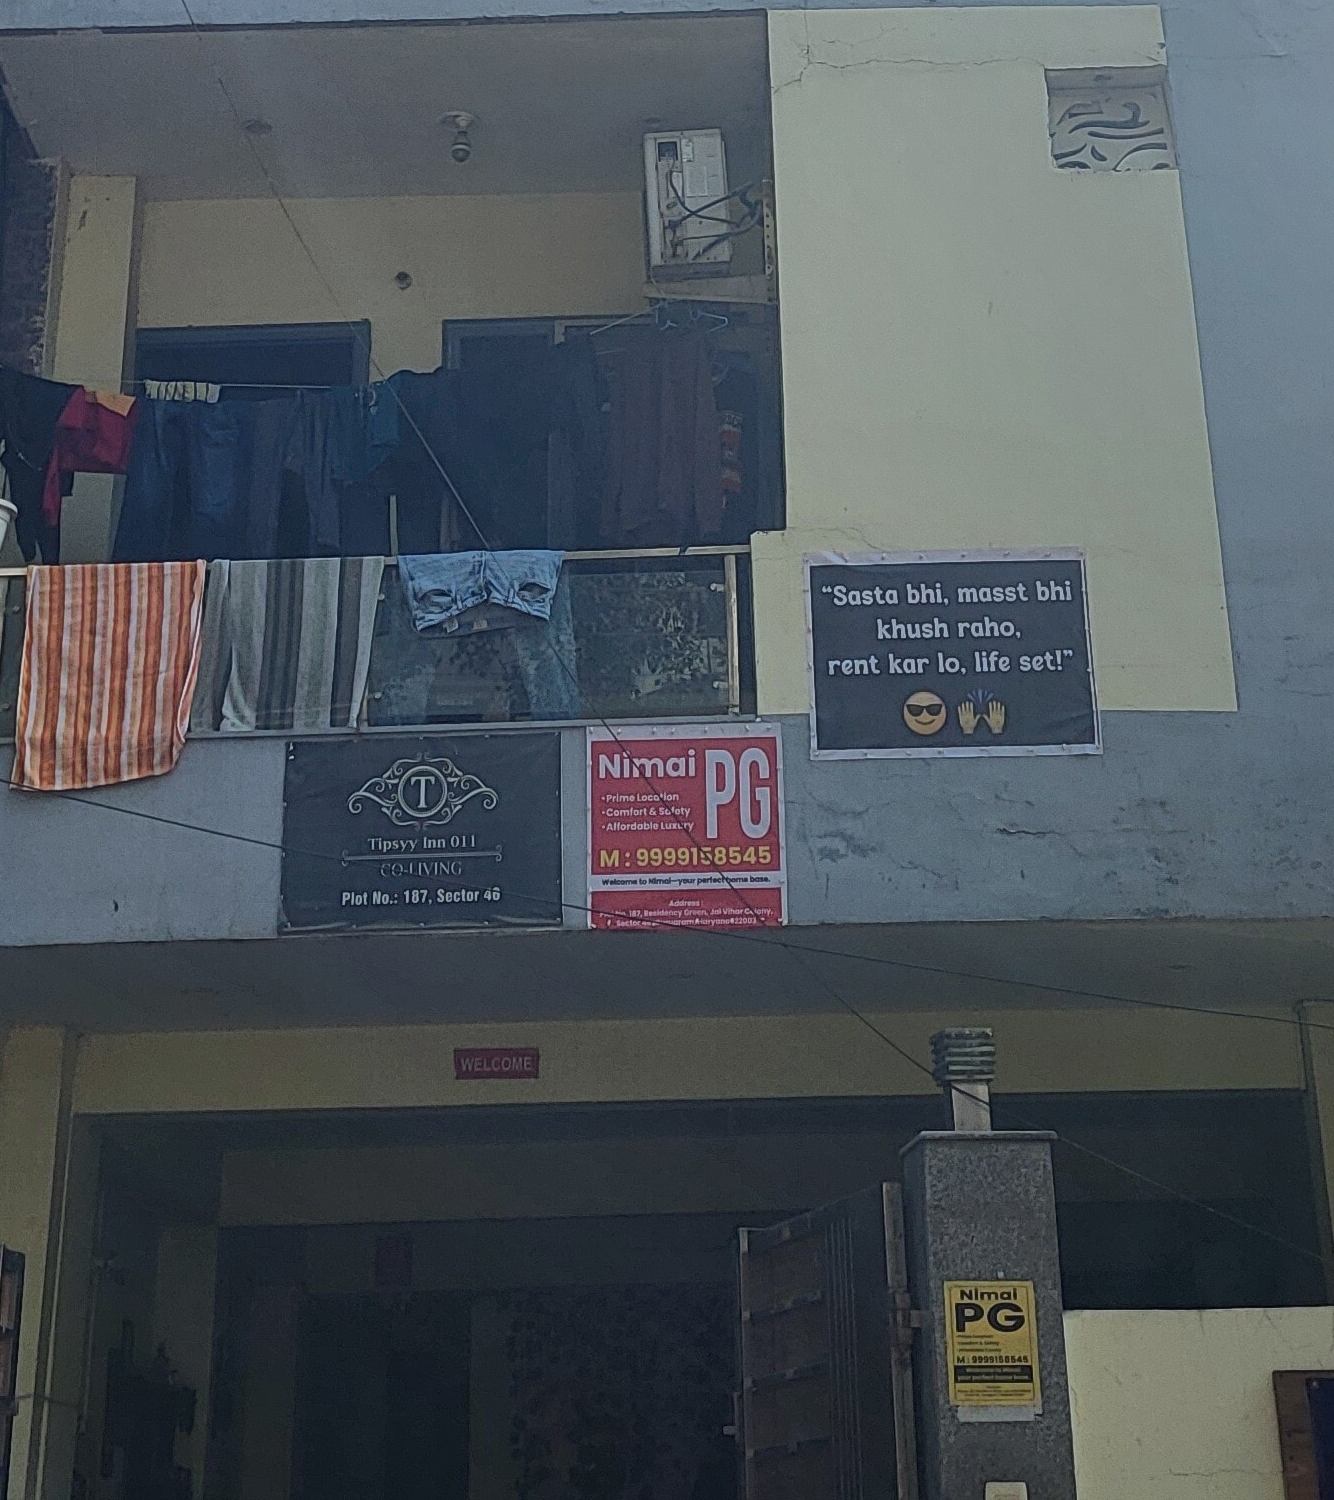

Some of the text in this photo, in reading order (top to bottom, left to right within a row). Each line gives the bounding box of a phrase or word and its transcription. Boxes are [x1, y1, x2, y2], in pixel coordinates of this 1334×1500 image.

[822, 580, 1072, 606] “Sasta bhi, masst bhi
[877, 617, 1021, 639] khush raho,
[828, 649, 1073, 675] rent kar lo, life set!”
[410, 776, 435, 809] T
[598, 747, 771, 839] Nimai PG
[606, 793, 679, 803] Prime Location
[606, 806, 691, 817] Comfort & Safety
[606, 821, 694, 831] Affordable Luxury
[367, 835, 476, 852] Tipsyy Inn 011
[600, 849, 619, 868] M
[636, 846, 771, 867] 9999158545
[380, 861, 463, 878] CO-LIVING
[601, 878, 637, 886] Welcome
[750, 874, 771, 883] base.
[341, 891, 368, 906] Plot
[372, 890, 398, 905] No.:
[403, 889, 433, 906] 187,
[436, 888, 480, 903] Sector
[460, 1057, 532, 1071] WELCOME
[960, 1287, 1017, 1301] Nimai
[955, 1302, 1025, 1332] PG
